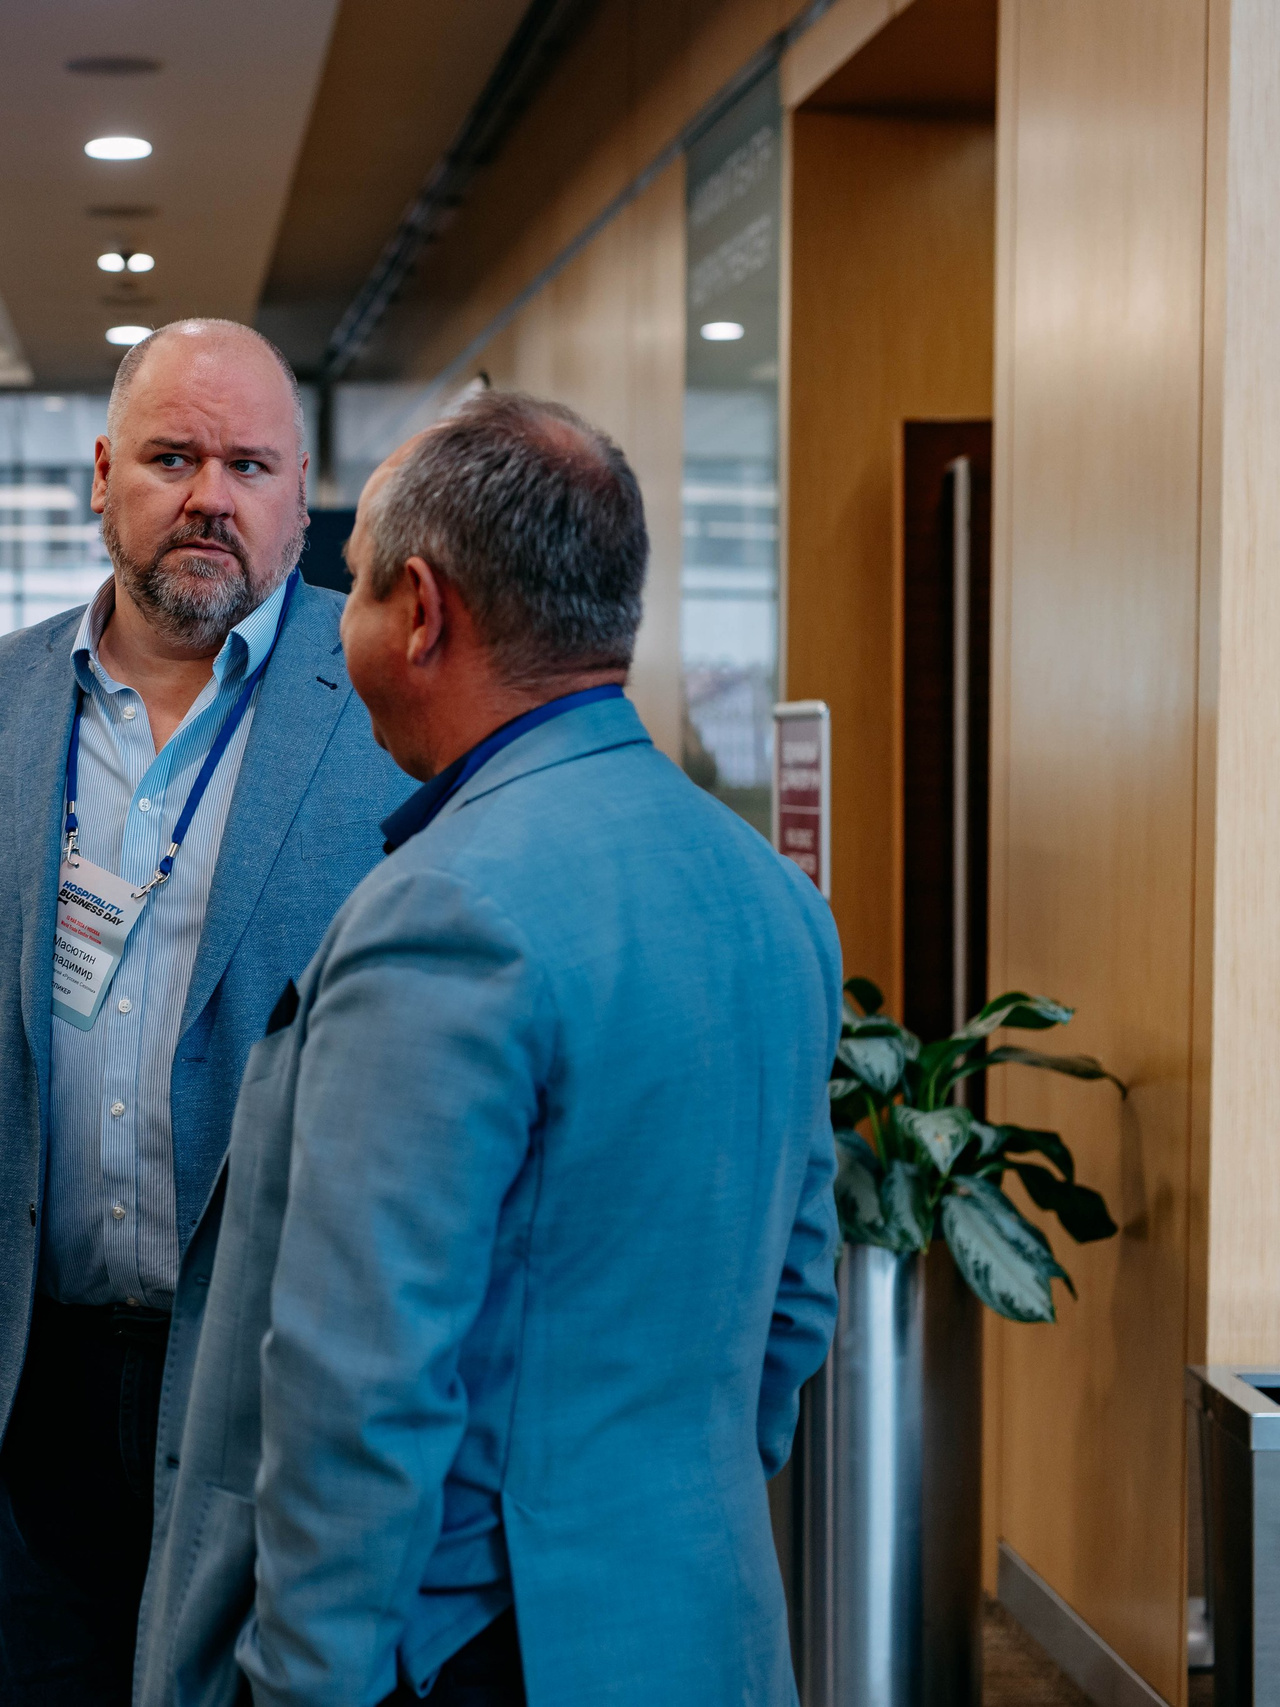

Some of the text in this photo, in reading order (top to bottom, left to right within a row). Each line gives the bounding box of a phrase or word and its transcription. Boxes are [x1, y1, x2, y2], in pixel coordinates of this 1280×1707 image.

[59, 888, 124, 926] BUSINESS DAY
[62, 880, 124, 915] HOSPITALITY
[53, 934, 97, 965] Масютин
[51, 952, 93, 981] ладимир
